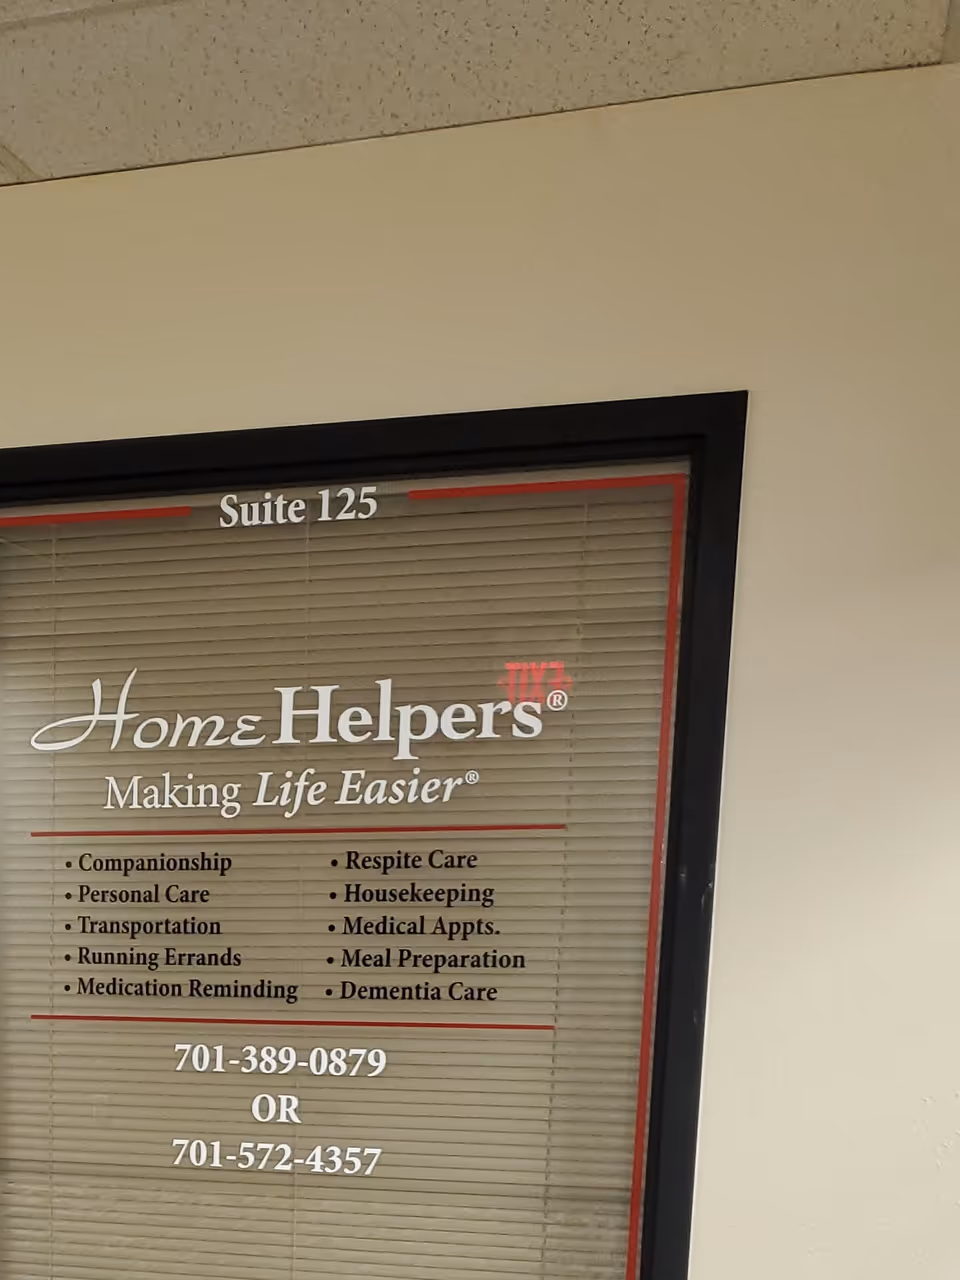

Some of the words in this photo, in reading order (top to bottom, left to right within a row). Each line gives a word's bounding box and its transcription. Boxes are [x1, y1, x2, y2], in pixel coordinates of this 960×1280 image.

[219, 491, 305, 528] Suite
[317, 486, 377, 522] 125
[104, 773, 241, 818] Making
[253, 768, 327, 819] Life
[78, 852, 232, 876] Companionship
[345, 850, 421, 875] Respite
[428, 850, 477, 869] Care
[78, 884, 159, 903] Personal
[164, 886, 210, 903] Care
[343, 883, 494, 907] Housekeeping
[77, 916, 221, 938] Transportation
[342, 916, 425, 936] Medical
[431, 917, 500, 940] Appts.
[78, 948, 159, 970] Running
[164, 948, 242, 967] Errands
[341, 948, 392, 968] Meal
[398, 950, 526, 974] Preparation
[77, 978, 182, 997] Medication
[188, 979, 299, 1003] Reminding
[339, 981, 441, 1001] Dementia
[447, 982, 498, 1001] Care
[174, 1043, 387, 1077] 701-389-0879
[251, 1094, 302, 1124] OR
[172, 1138, 381, 1175] 701-572-4357
